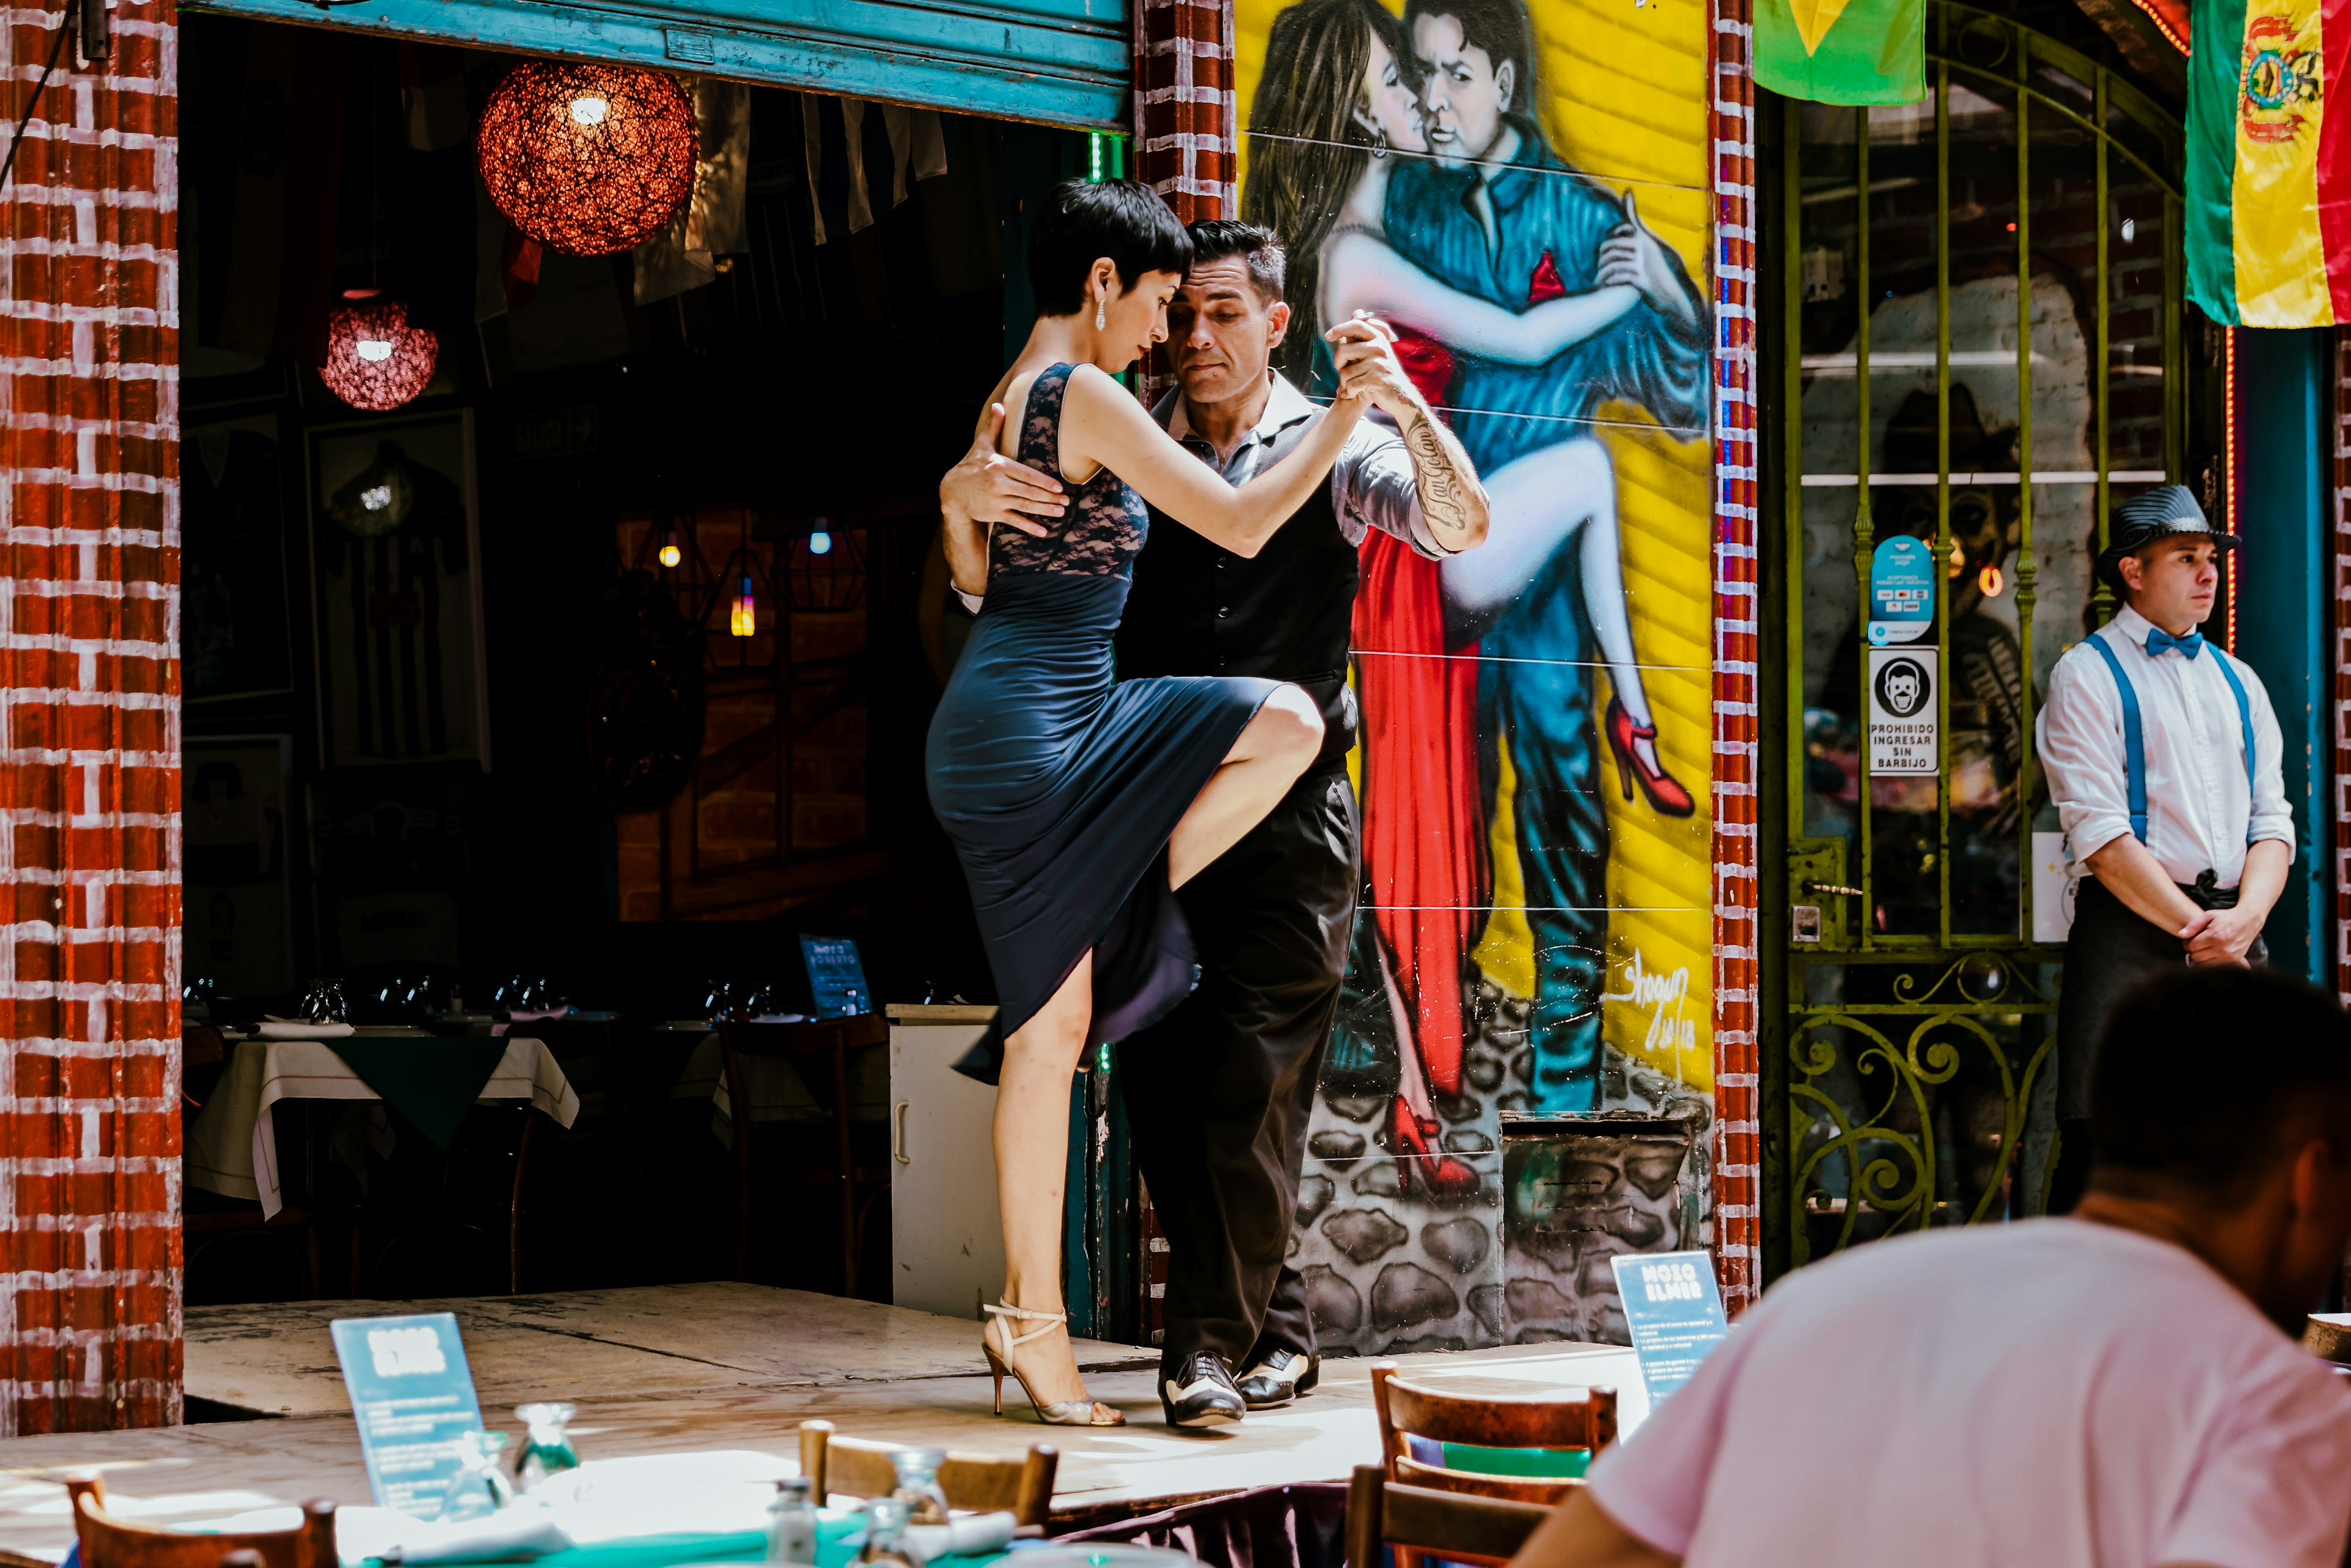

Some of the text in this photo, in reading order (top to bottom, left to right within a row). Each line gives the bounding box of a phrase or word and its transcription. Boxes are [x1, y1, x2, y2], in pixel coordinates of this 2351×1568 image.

[1872, 724, 1933, 733] PROHIBIDO
[1874, 736, 1931, 745] INGRESAR
[1893, 748, 1911, 756] SIN
[1878, 759, 1927, 768] BARBIJO
[1641, 1264, 1696, 1283] MOZO
[1646, 1281, 1703, 1302] ELMER
